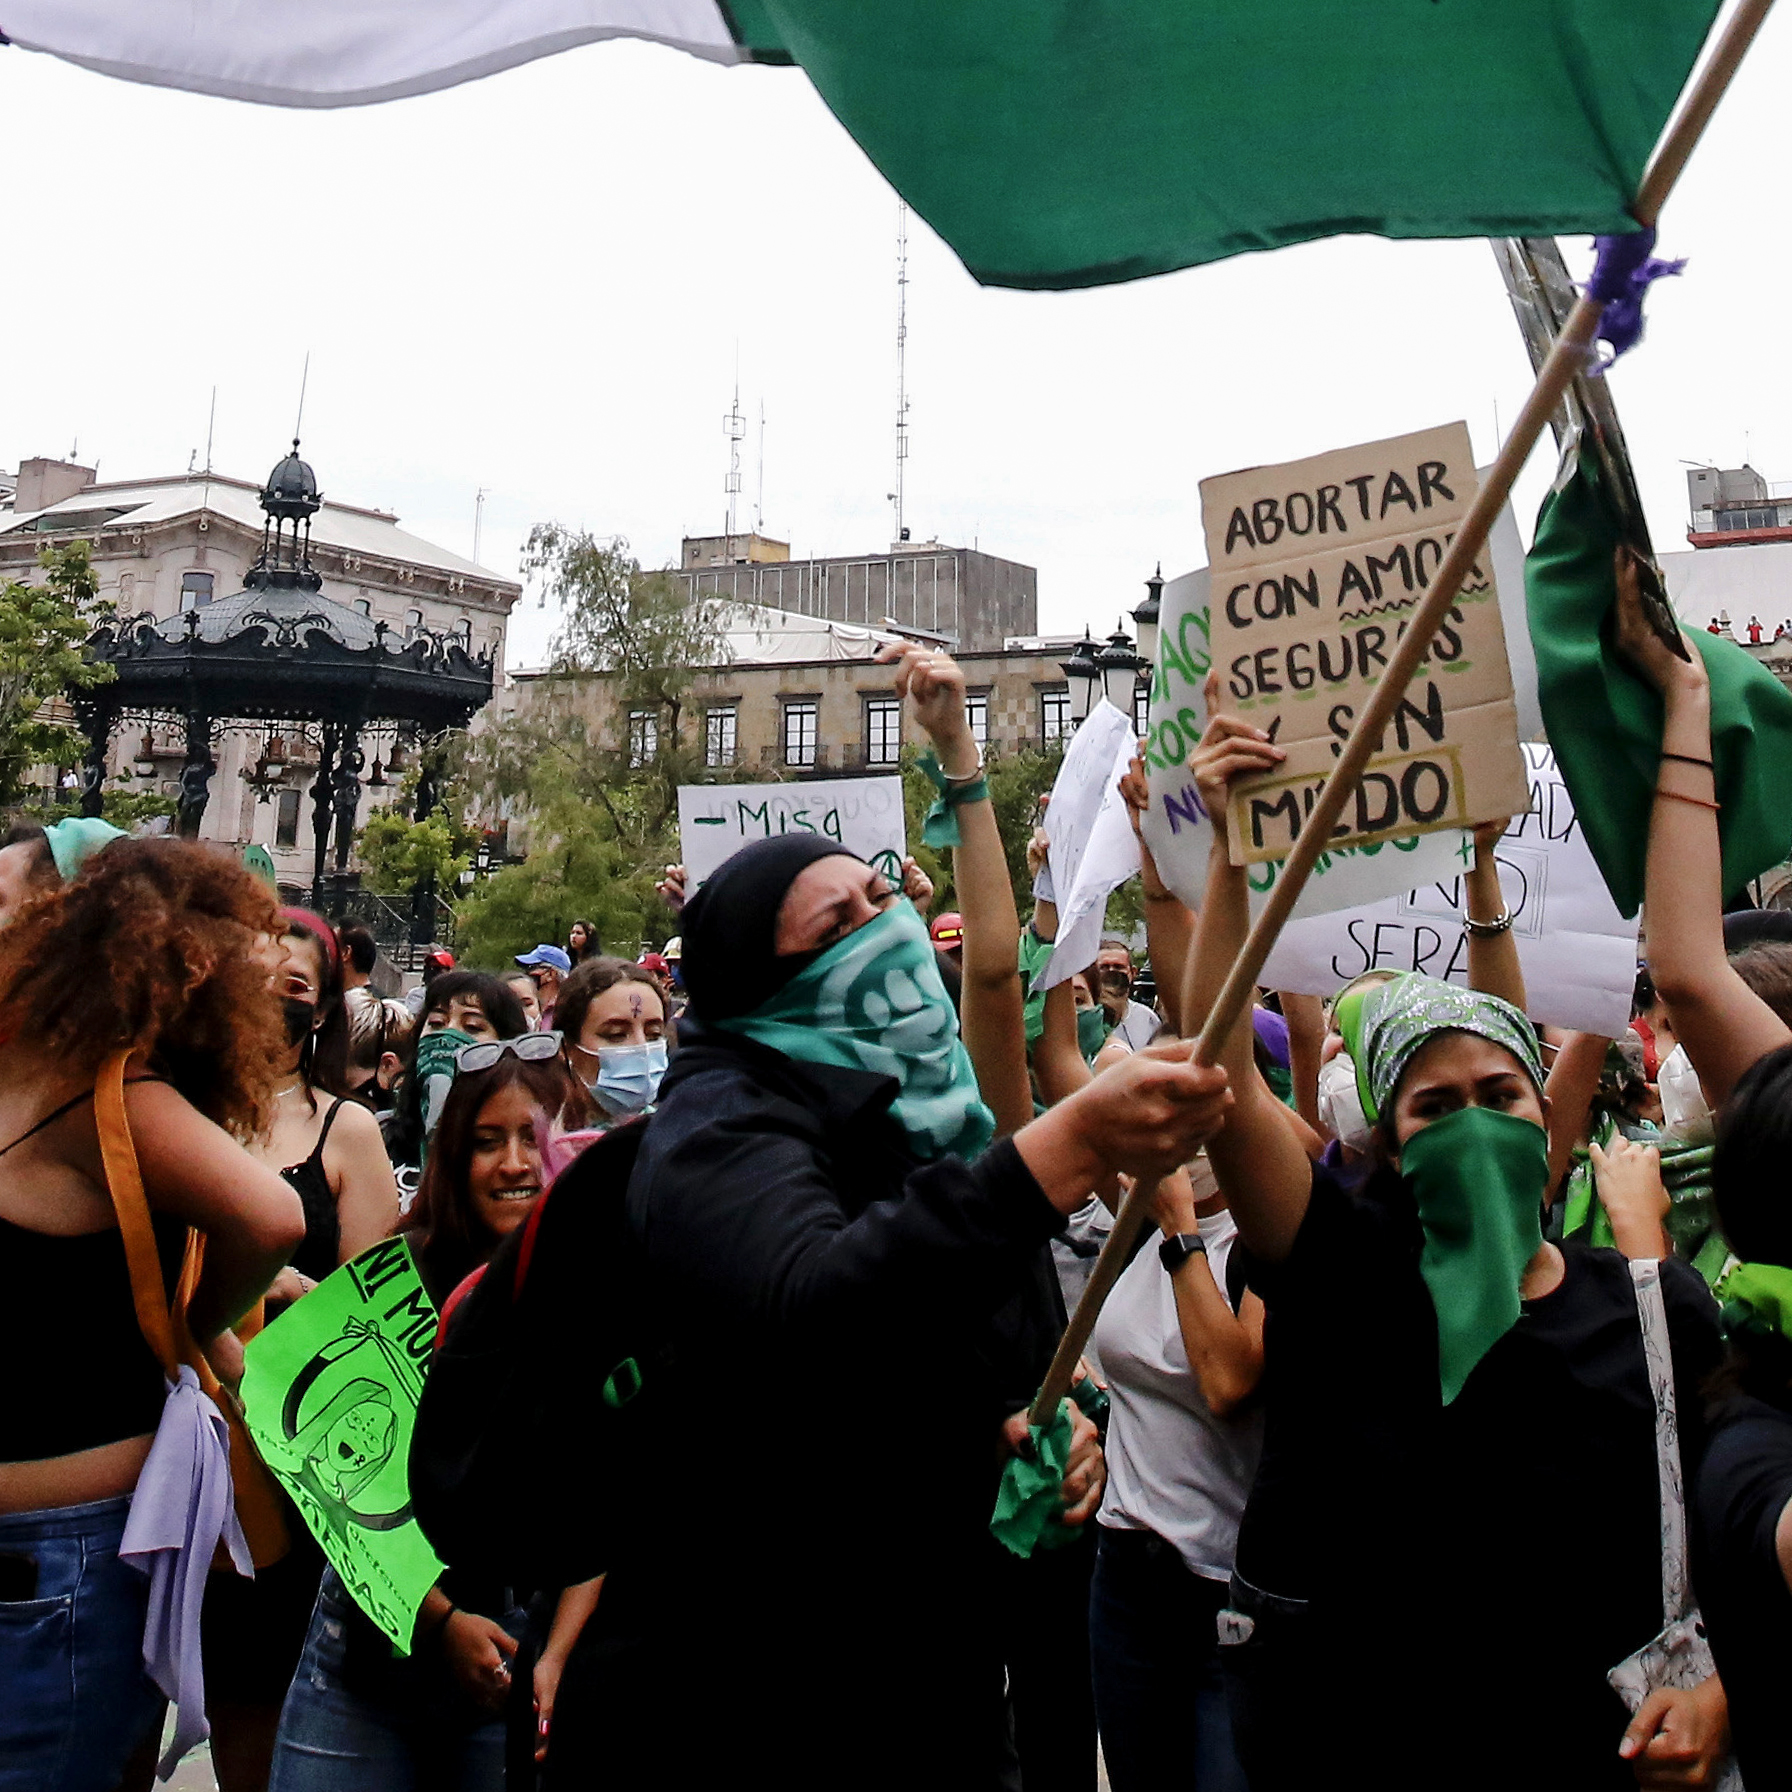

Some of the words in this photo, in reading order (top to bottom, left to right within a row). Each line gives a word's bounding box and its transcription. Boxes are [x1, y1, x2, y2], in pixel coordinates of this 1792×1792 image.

[1225, 462, 1455, 555] ABORTAR
[1225, 568, 1320, 629] CON
[1337, 531, 1484, 608] AMO
[1327, 681, 1445, 758] SN
[353, 1236, 411, 1299] NI
